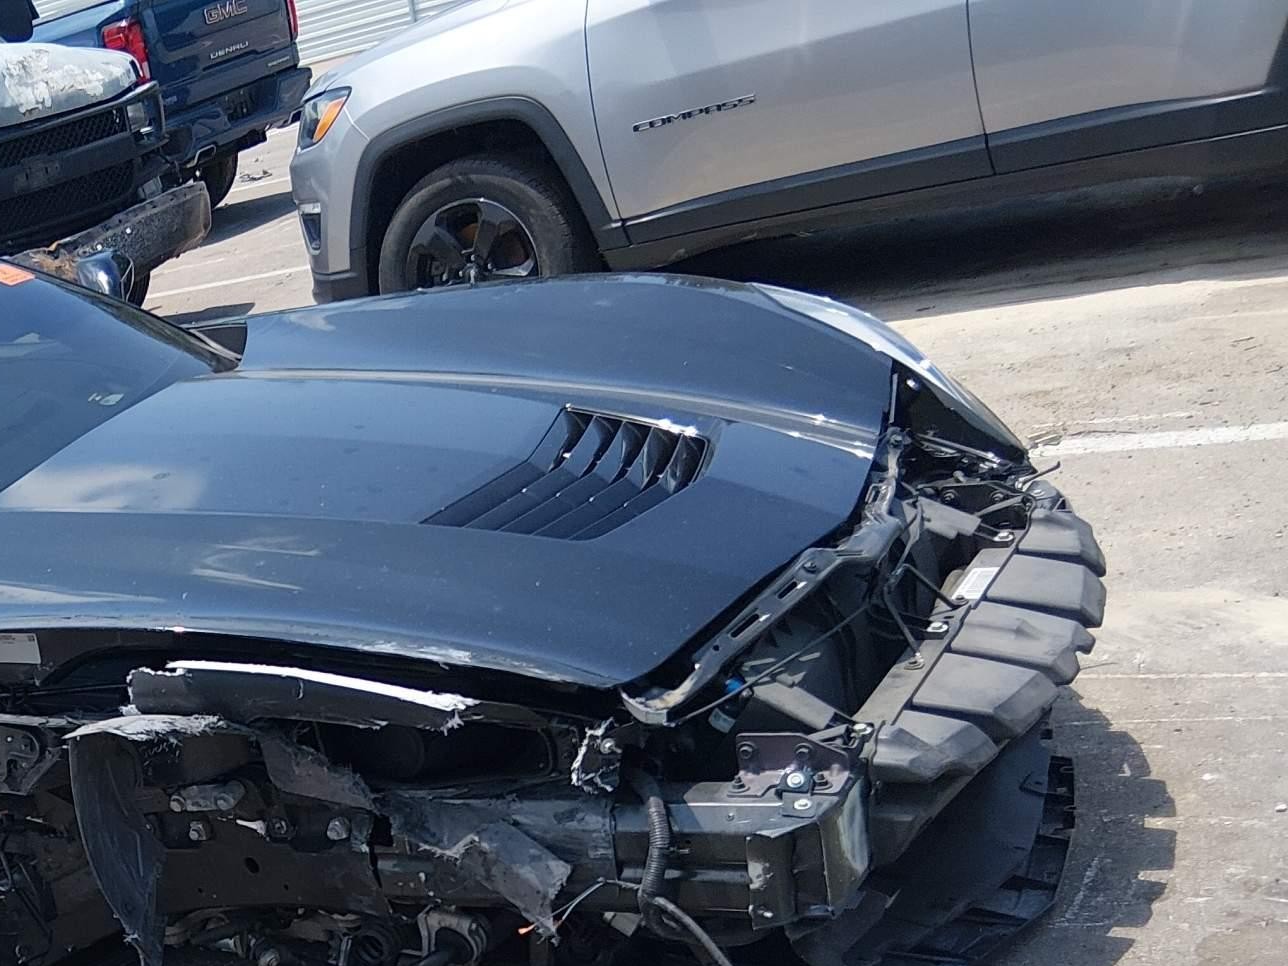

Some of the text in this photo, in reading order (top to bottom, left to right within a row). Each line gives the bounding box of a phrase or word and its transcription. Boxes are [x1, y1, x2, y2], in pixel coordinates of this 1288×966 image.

[204, 0, 248, 25] GMC
[209, 40, 249, 60] DENALI
[632, 93, 757, 132] COMPASS
